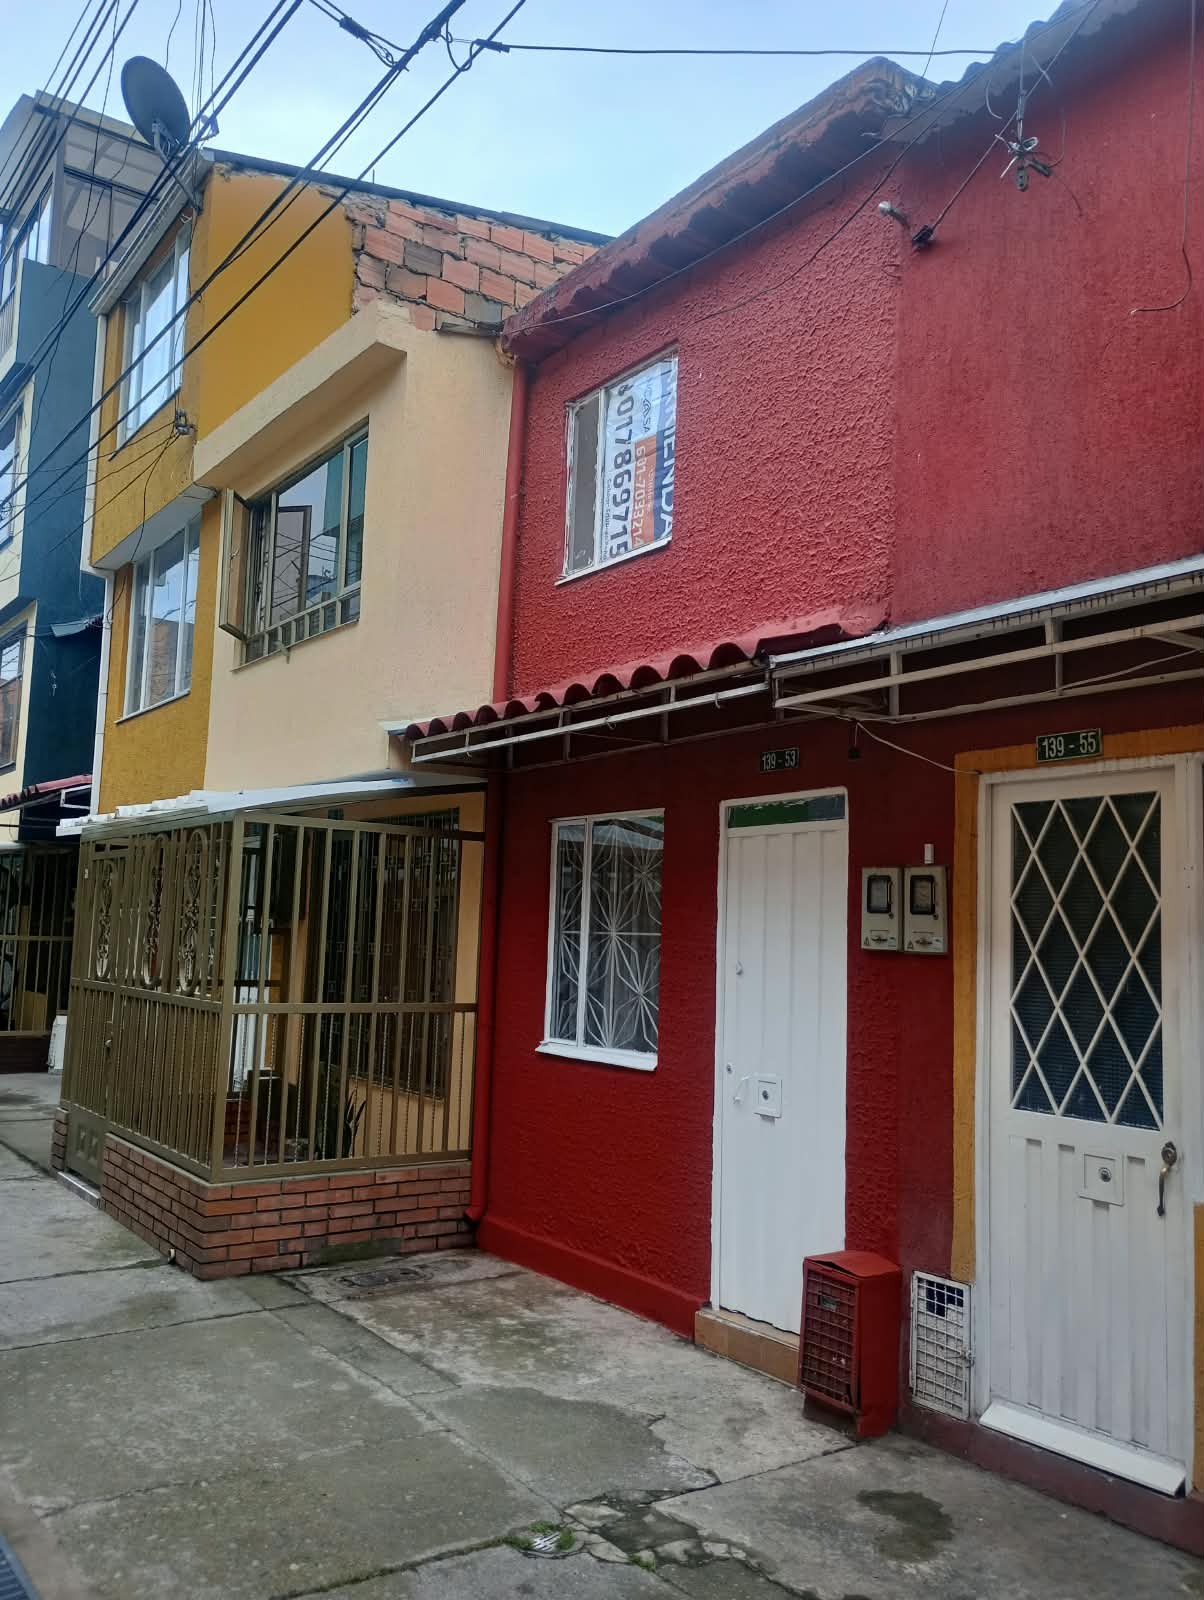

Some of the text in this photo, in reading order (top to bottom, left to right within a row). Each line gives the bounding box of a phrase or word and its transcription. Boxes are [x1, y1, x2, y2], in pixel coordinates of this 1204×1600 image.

[660, 358, 676, 538] IENDA
[1041, 736, 1065, 759] 139
[1079, 732, 1097, 754] 55
[762, 753, 776, 771] 139
[784, 750, 796, 767] 53
